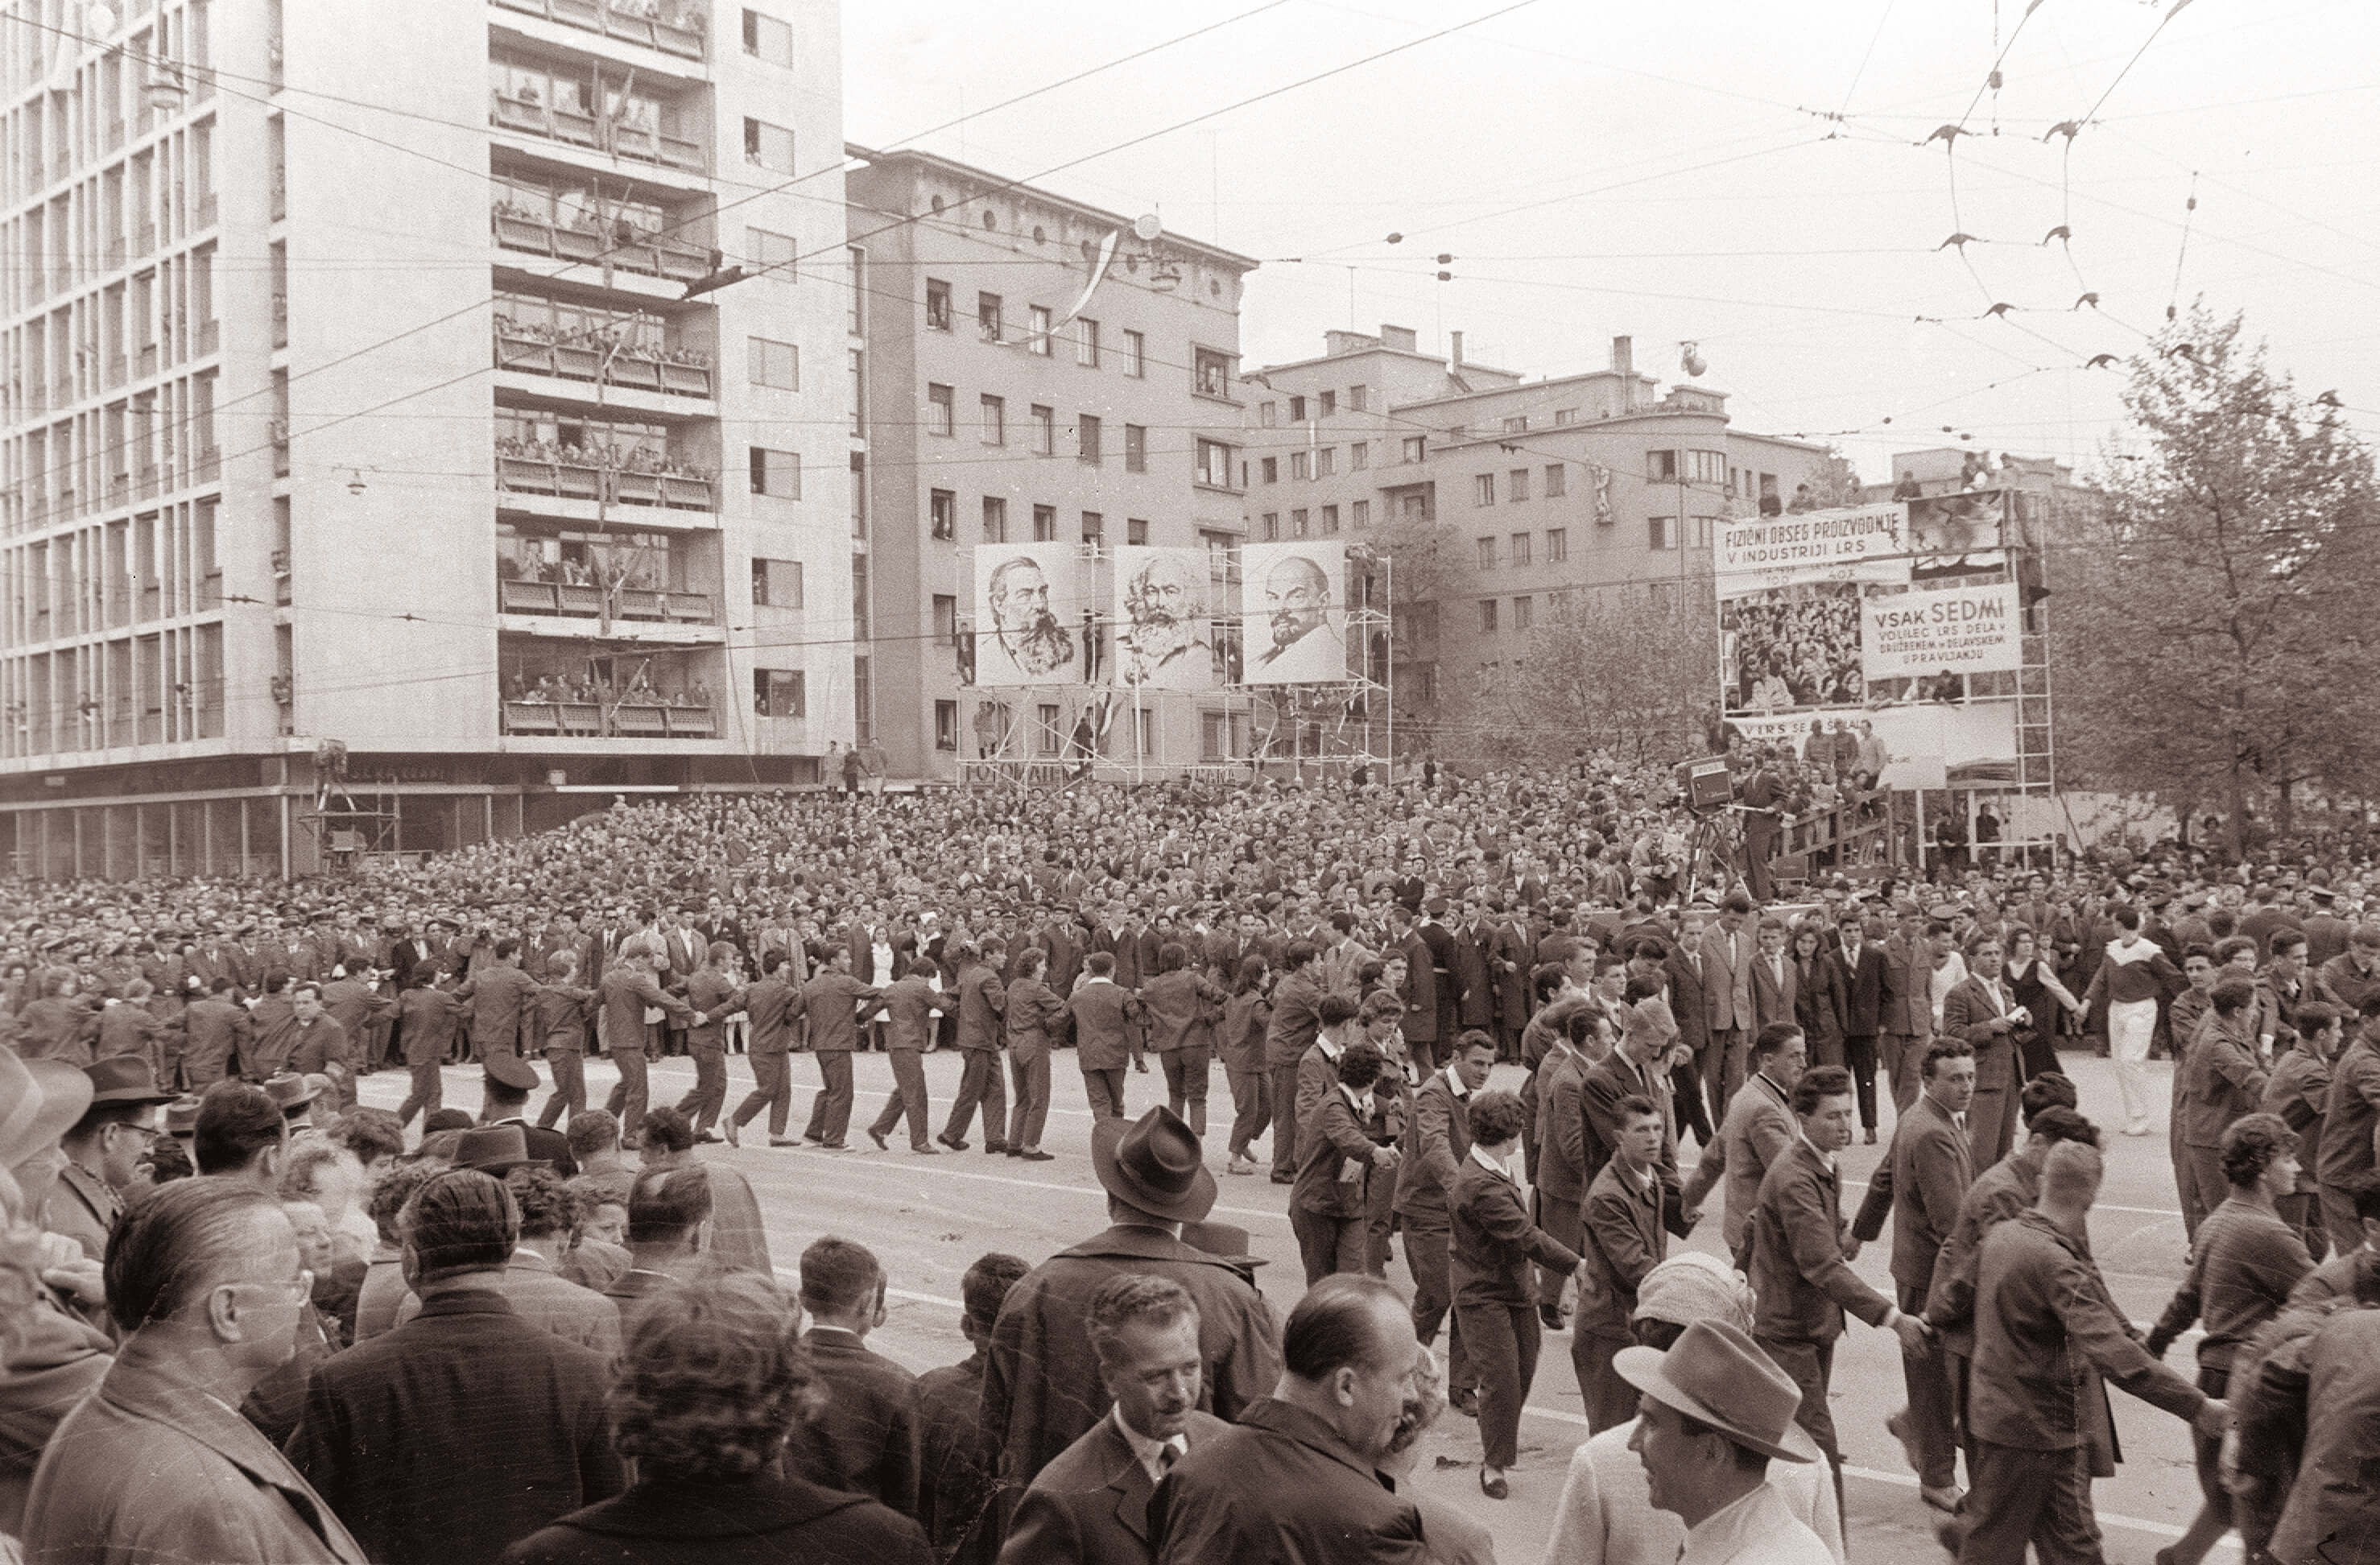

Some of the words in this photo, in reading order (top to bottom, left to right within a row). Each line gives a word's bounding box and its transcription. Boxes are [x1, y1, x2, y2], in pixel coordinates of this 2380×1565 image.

[1726, 526, 1766, 547] FIZIČNI
[1771, 523, 1808, 544] OBSEG
[1814, 513, 1899, 539] PROIZVODNJE
[1727, 552, 1737, 564] V
[1742, 543, 1827, 563] INDUSTRIJI
[1837, 539, 1865, 555] LRS
[1874, 610, 1925, 627] VSAK
[1932, 597, 2004, 623] SEDMI
[1938, 625, 1959, 636] LRS
[1966, 623, 1996, 634] DELA
[1792, 723, 1805, 733] SE
